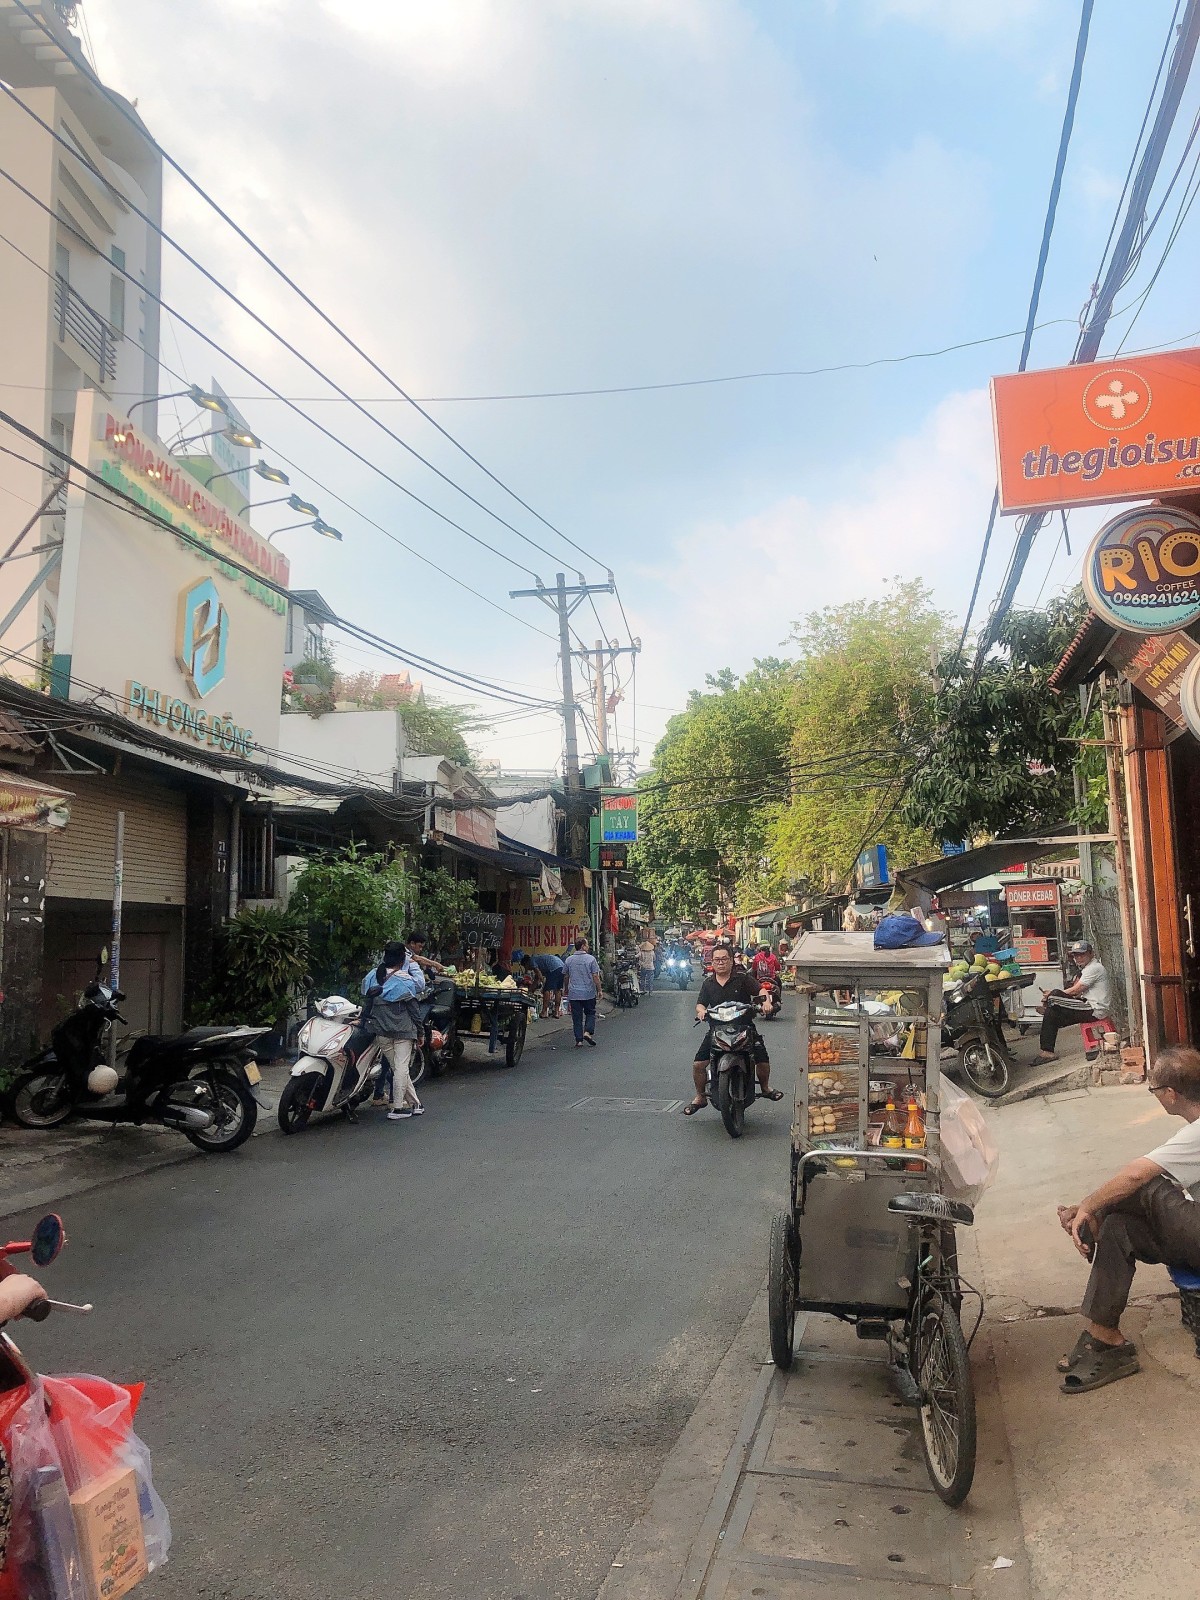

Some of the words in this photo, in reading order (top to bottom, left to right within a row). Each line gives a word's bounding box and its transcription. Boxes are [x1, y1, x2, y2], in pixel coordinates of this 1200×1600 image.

[1022, 433, 1200, 481] thegioisu
[1099, 532, 1200, 592] RIO
[1155, 580, 1196, 592] COFFEE
[1113, 589, 1200, 605] 0968241624
[1151, 664, 1169, 682] PHÊ
[1169, 641, 1191, 663] MÁY
[609, 811, 630, 829] TÂY
[1032, 889, 1054, 901] KEBAB
[543, 925, 558, 947] SA
